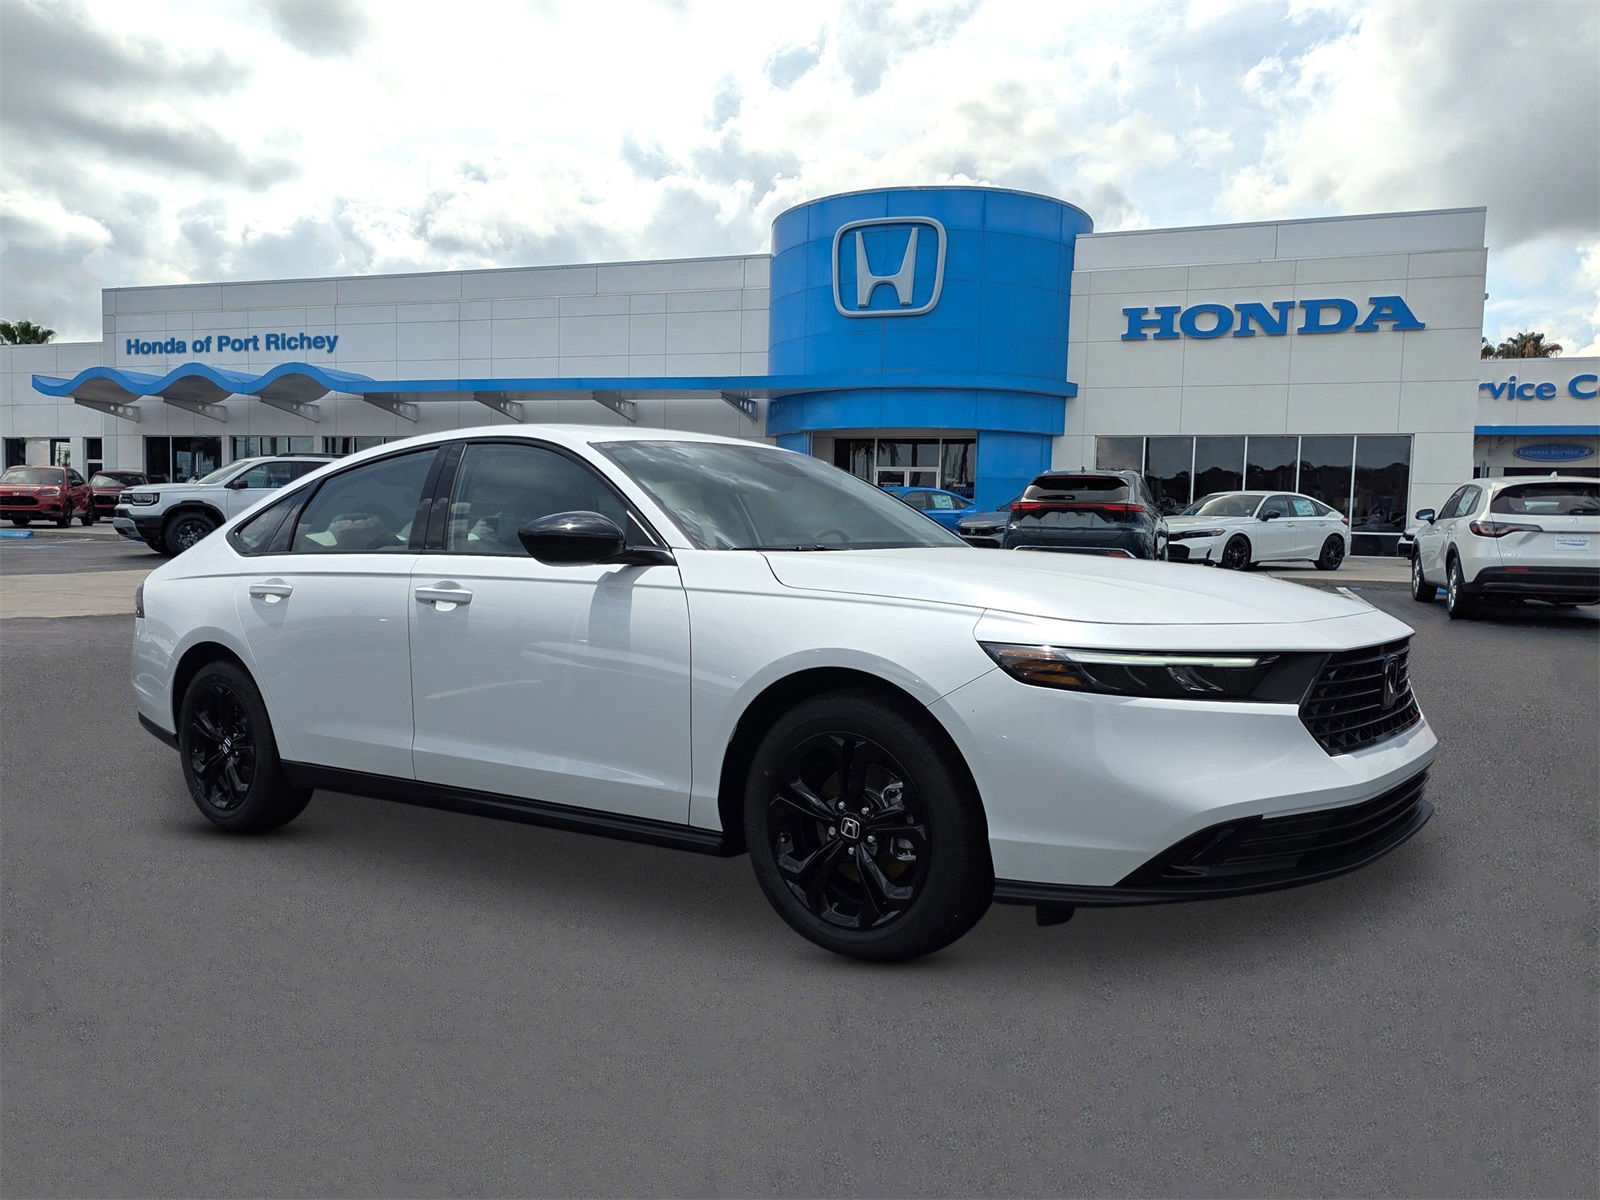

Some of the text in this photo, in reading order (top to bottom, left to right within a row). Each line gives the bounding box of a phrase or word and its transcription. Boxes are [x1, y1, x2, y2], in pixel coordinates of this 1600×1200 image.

[1121, 295, 1426, 340] HONDA
[126, 332, 339, 355] Honda of Port Richey
